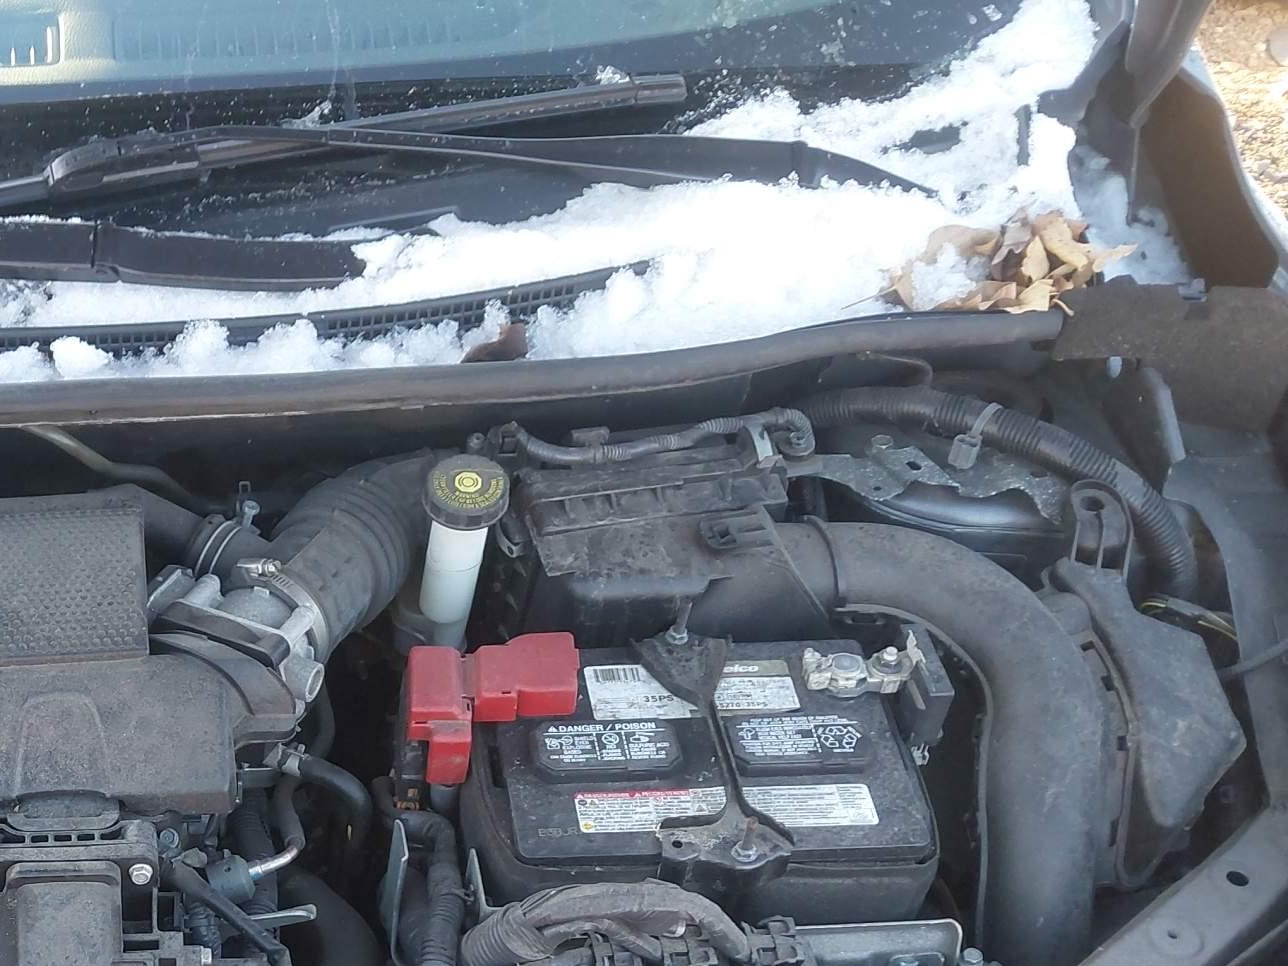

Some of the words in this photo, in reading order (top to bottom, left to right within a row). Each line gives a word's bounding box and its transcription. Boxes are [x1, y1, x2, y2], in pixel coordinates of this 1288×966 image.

[643, 694, 674, 703] 35PS
[558, 724, 604, 733] DANGER
[615, 722, 656, 731] POISON
